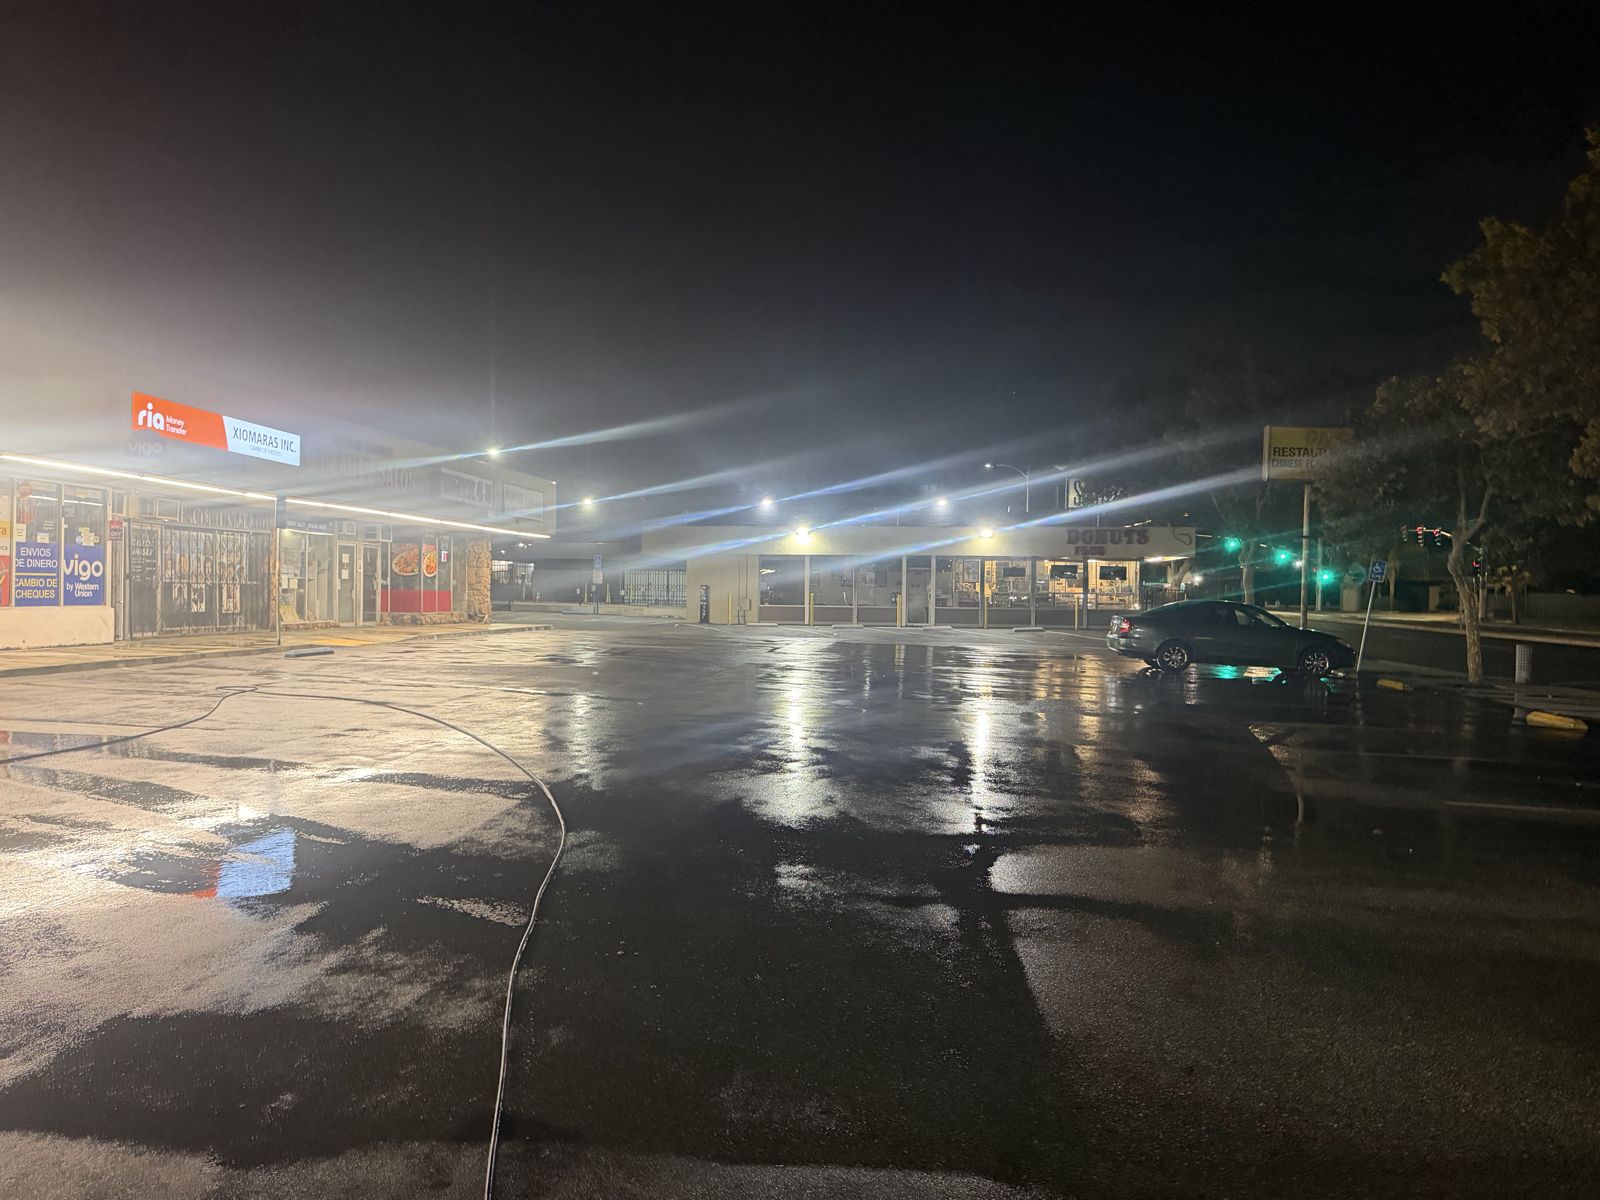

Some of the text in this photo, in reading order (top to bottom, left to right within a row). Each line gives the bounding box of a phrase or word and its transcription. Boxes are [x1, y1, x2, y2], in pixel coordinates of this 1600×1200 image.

[138, 402, 185, 430] ria Money
[166, 424, 188, 436] Transfer
[232, 426, 297, 453] XIOMARAS INC.
[1271, 458, 1304, 469] CHINESE
[1067, 528, 1150, 545] DONUTS
[20, 547, 52, 557] ENVIOS
[26, 559, 58, 568] DINERO
[63, 553, 104, 581] vigo
[15, 578, 58, 588] CAMBIO DE
[66, 582, 73, 592] by
[15, 589, 55, 599] CHEQUES
[74, 589, 93, 598] Union
